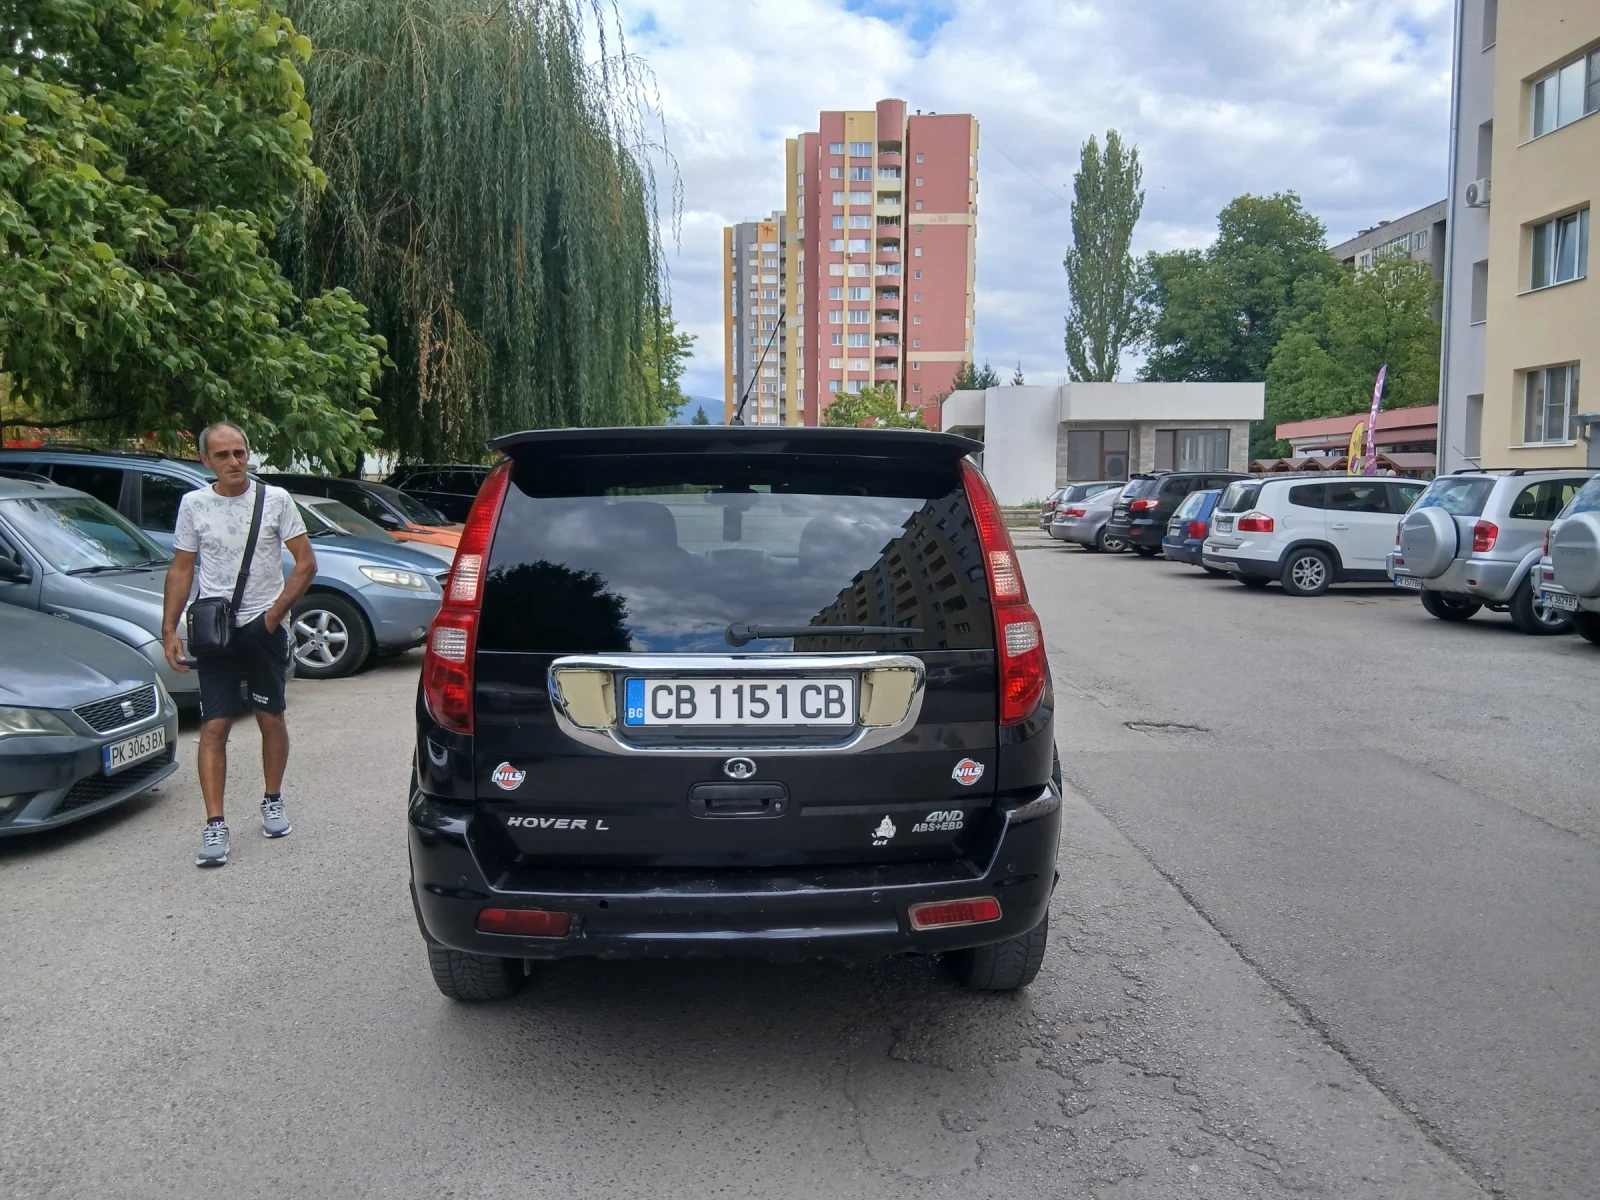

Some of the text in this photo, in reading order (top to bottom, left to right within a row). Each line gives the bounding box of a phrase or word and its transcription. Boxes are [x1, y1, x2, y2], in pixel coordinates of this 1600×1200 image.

[1557, 546, 1586, 556] TOYOTA
[1546, 594, 1577, 606] PK 3629 BT
[651, 684, 846, 719] CB 1151 CB
[628, 707, 643, 718] BG
[112, 730, 163, 765] PK 3063 BX
[494, 771, 523, 781] NILS
[954, 766, 983, 777] NILS
[925, 810, 964, 822] 4WD
[507, 817, 609, 830] HOVER L
[912, 821, 963, 832] ABS+EBD
